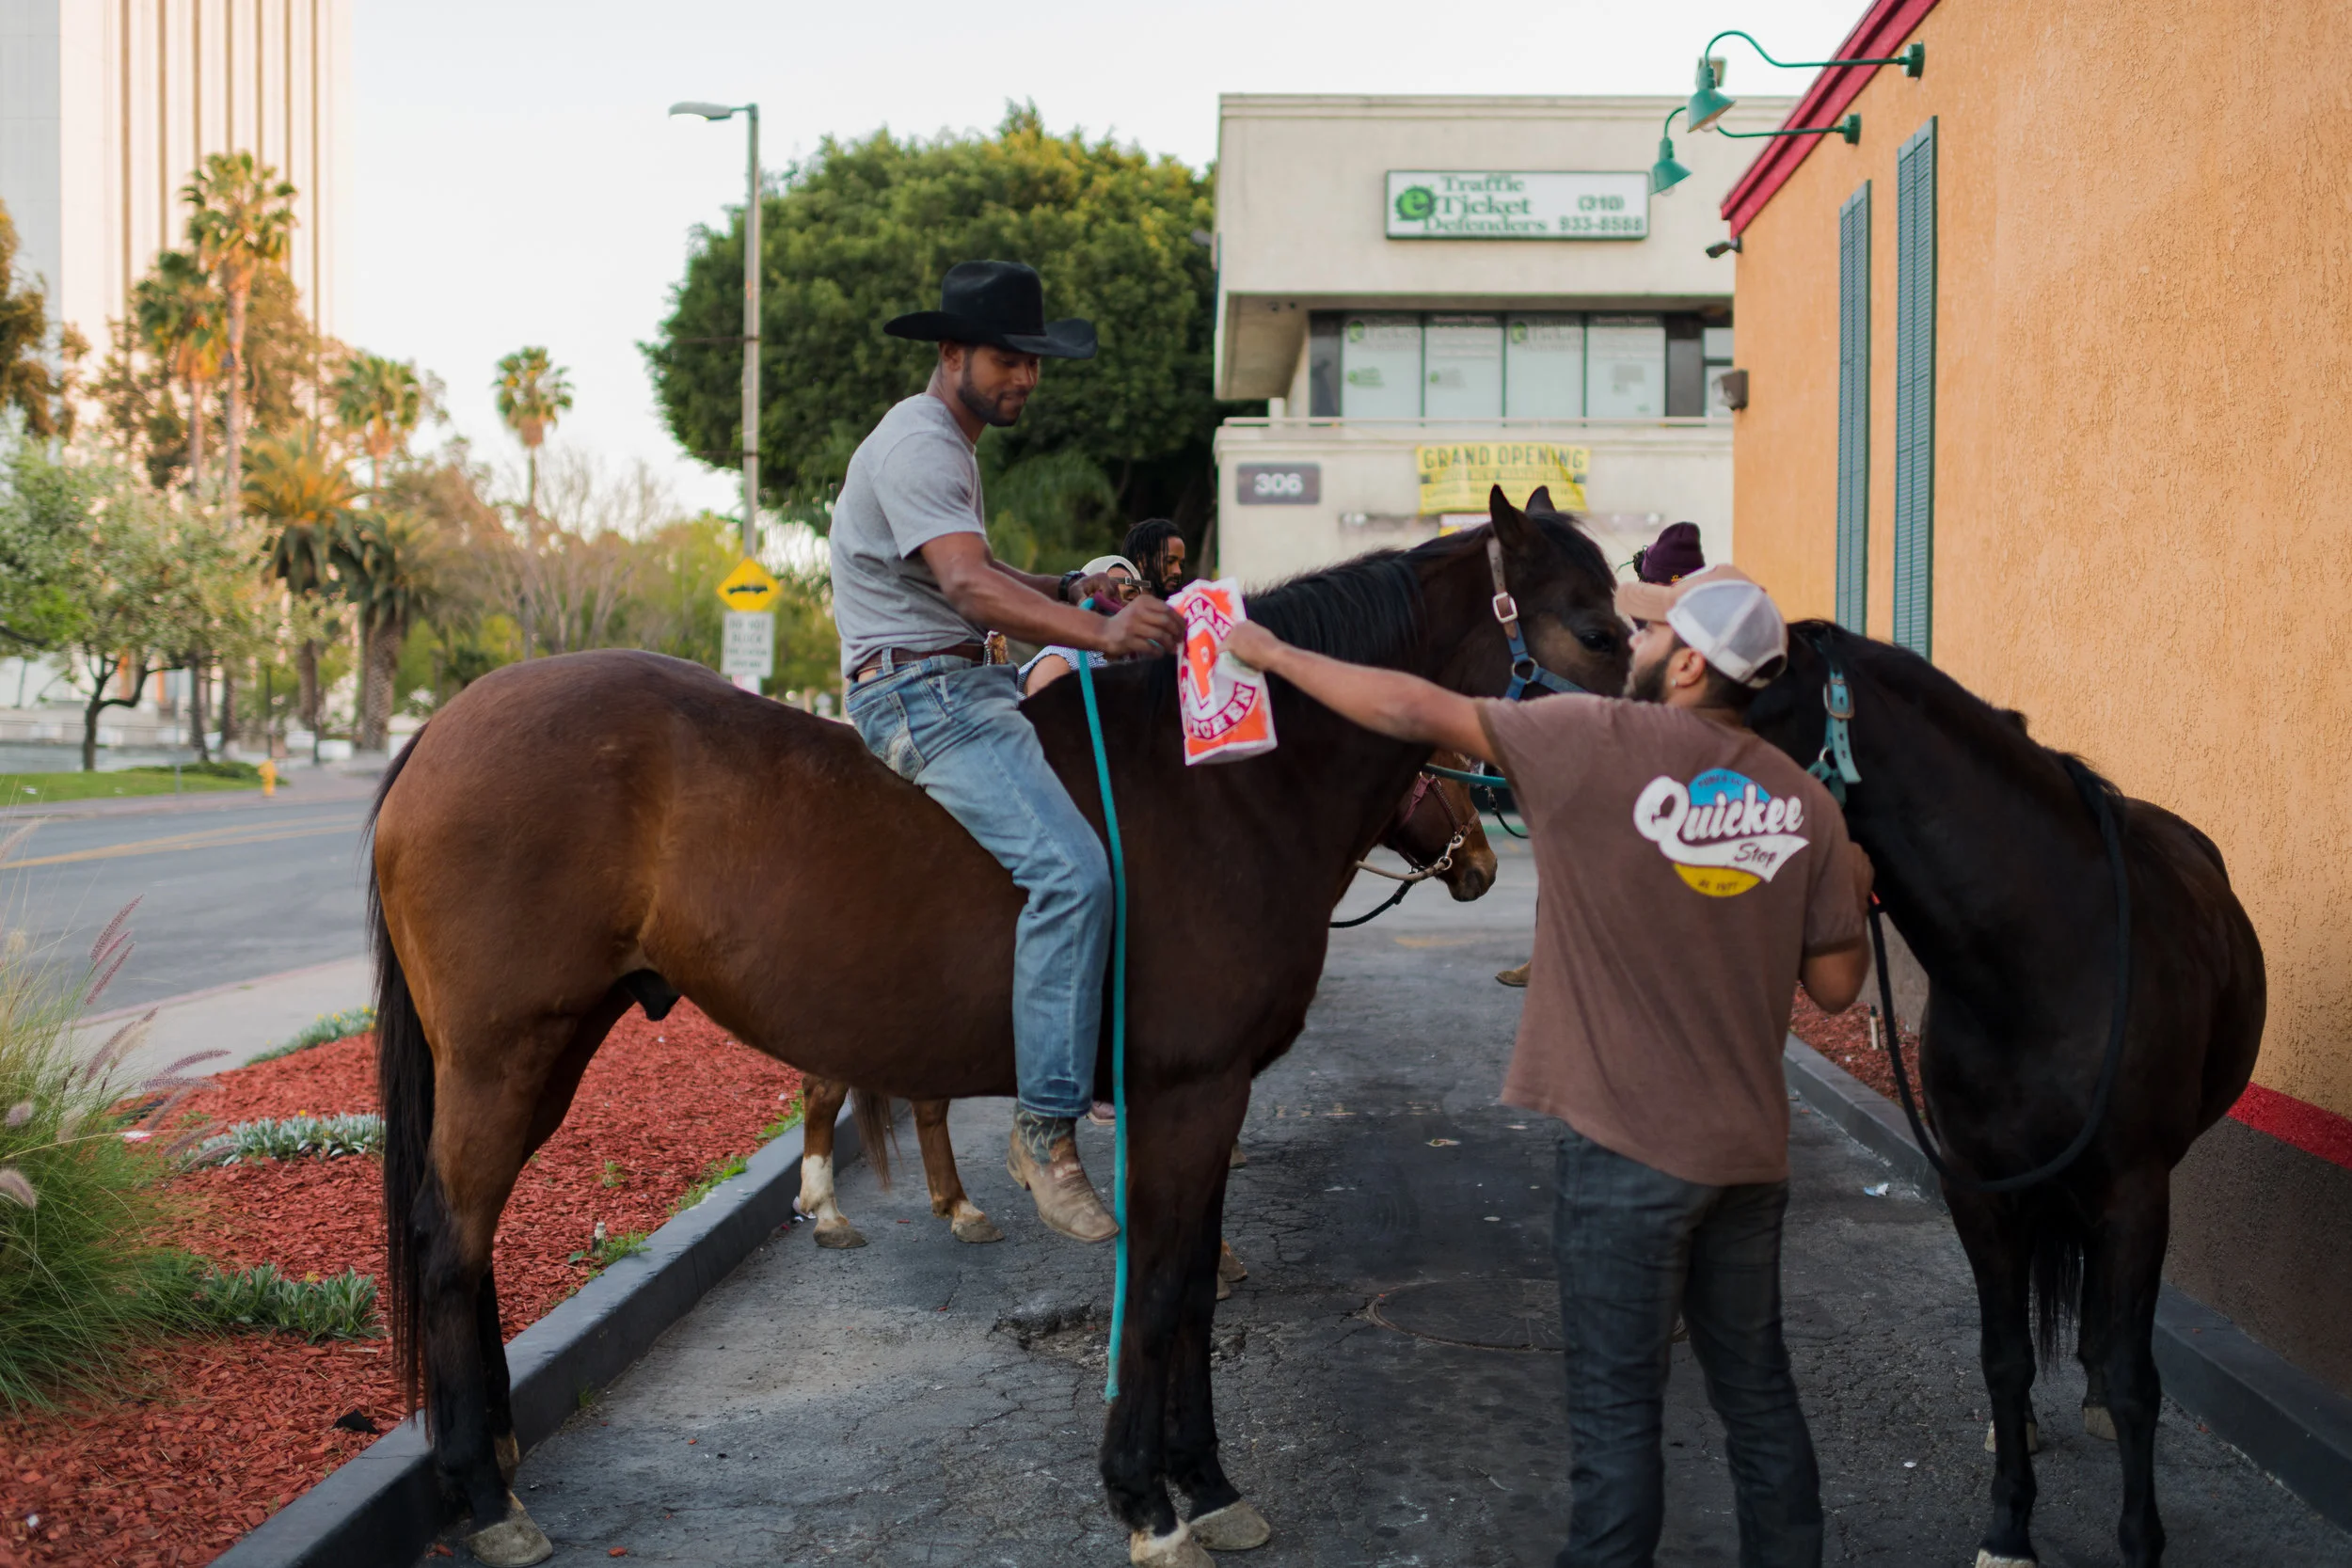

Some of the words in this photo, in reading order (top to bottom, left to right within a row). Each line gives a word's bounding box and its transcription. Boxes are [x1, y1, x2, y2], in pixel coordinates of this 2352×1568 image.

[1439, 173, 1525, 192] Traffic
[1436, 195, 1533, 215] Ticket
[1423, 214, 1548, 231] Defenders
[1423, 446, 1489, 469] GRAND
[1497, 444, 1584, 468] OPENING
[1254, 473, 1303, 496] 306
[1634, 775, 1804, 842] Quickee
[1734, 843, 1777, 869] Stop
